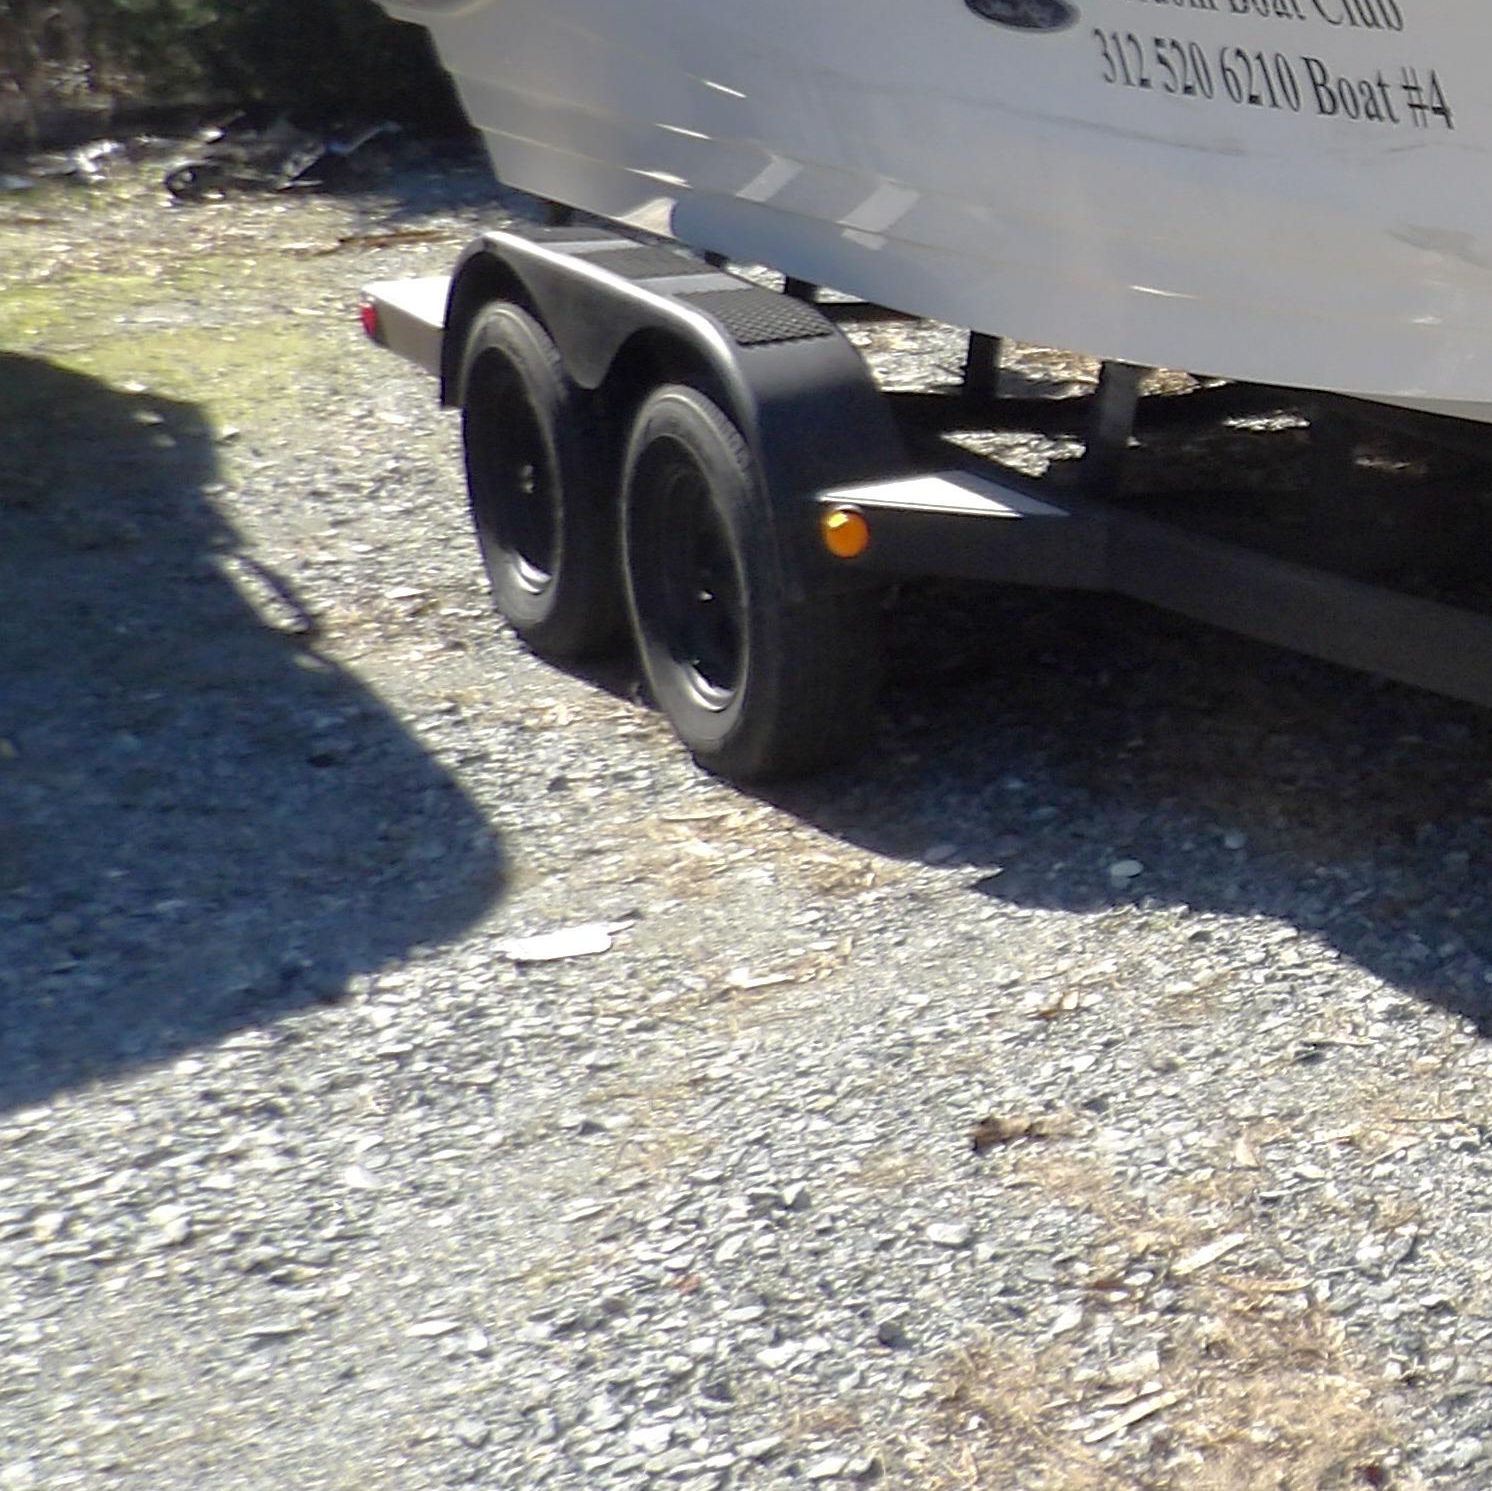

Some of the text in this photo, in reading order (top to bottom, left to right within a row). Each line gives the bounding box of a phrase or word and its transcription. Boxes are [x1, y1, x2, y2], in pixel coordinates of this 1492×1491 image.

[1094, 27, 1455, 130] 312 520 6210 Boat #4
